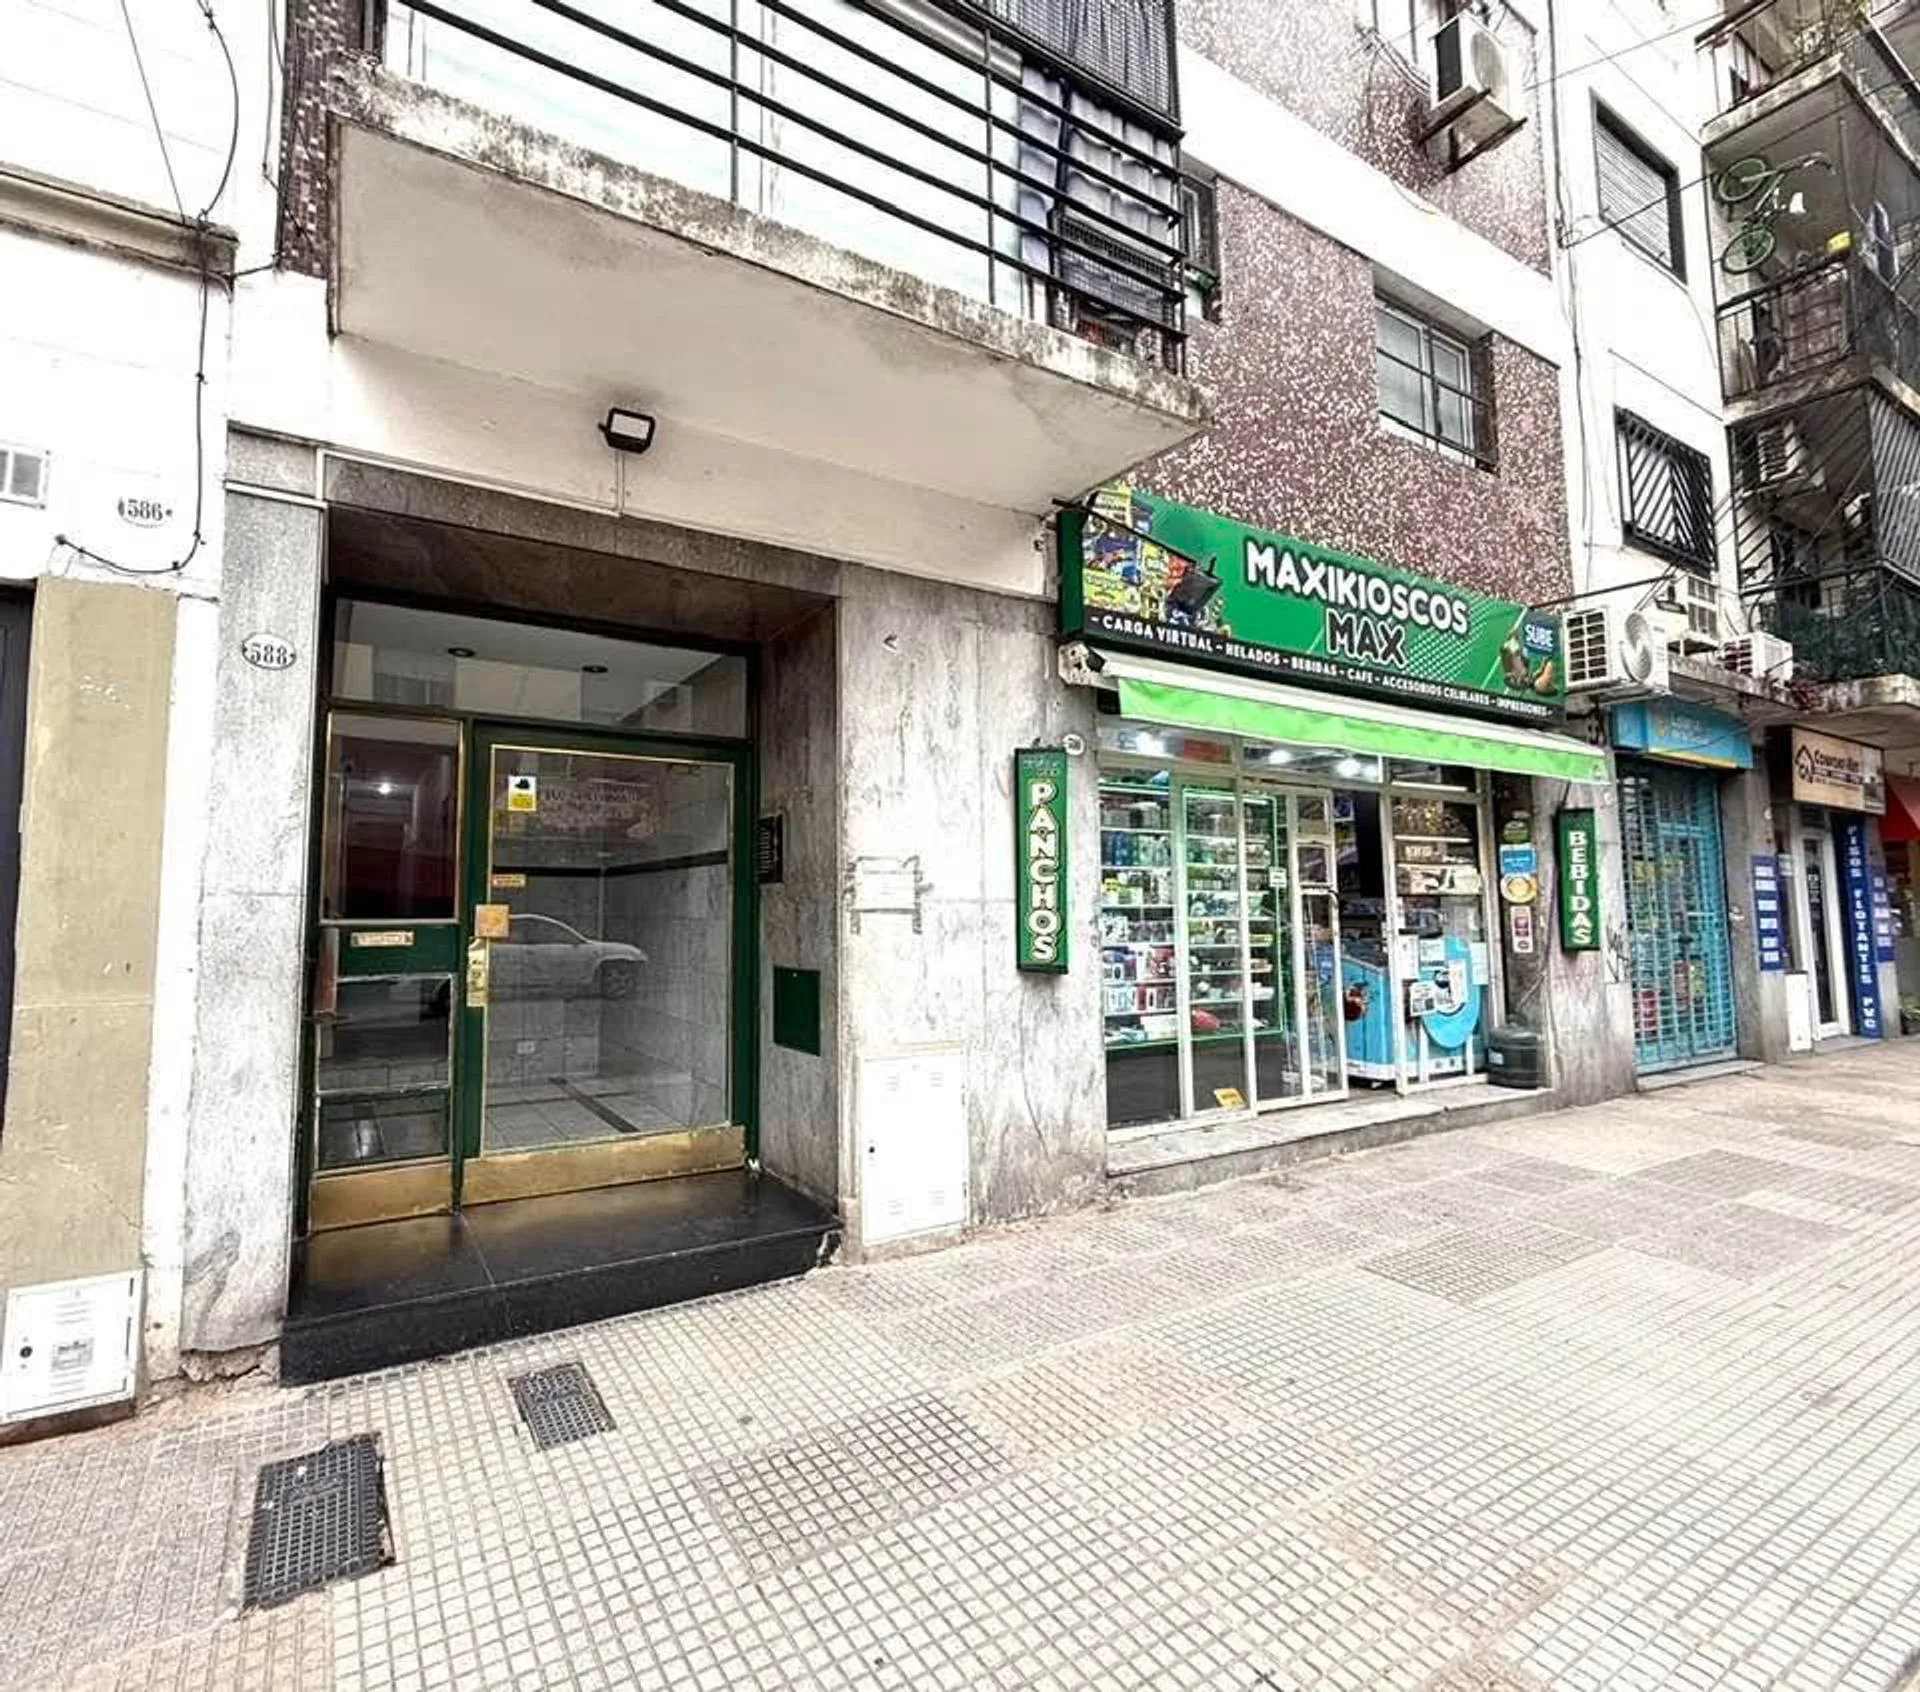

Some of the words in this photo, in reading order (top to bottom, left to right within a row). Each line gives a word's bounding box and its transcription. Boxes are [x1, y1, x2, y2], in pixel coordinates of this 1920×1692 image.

[127, 498, 163, 521] 586
[1245, 540, 1469, 635] MAXIKIOSCOS
[250, 642, 287, 665] 588
[1103, 615, 1154, 639] CARGA
[1156, 627, 1214, 652] VIRTUAL
[1225, 643, 1281, 666] HELADOS
[1291, 657, 1338, 677] BEBIDAS
[1347, 667, 1373, 685] CAFE
[1382, 677, 1442, 698] ACCESORIOS
[1326, 608, 1408, 669] MAX
[1525, 624, 1554, 648] SUBE
[1028, 780, 1061, 964] PANCHOS
[1568, 830, 1593, 945] BEBIDAS
[1853, 888, 1874, 985] FLOTANTES
[1862, 996, 1877, 1029] PVC
